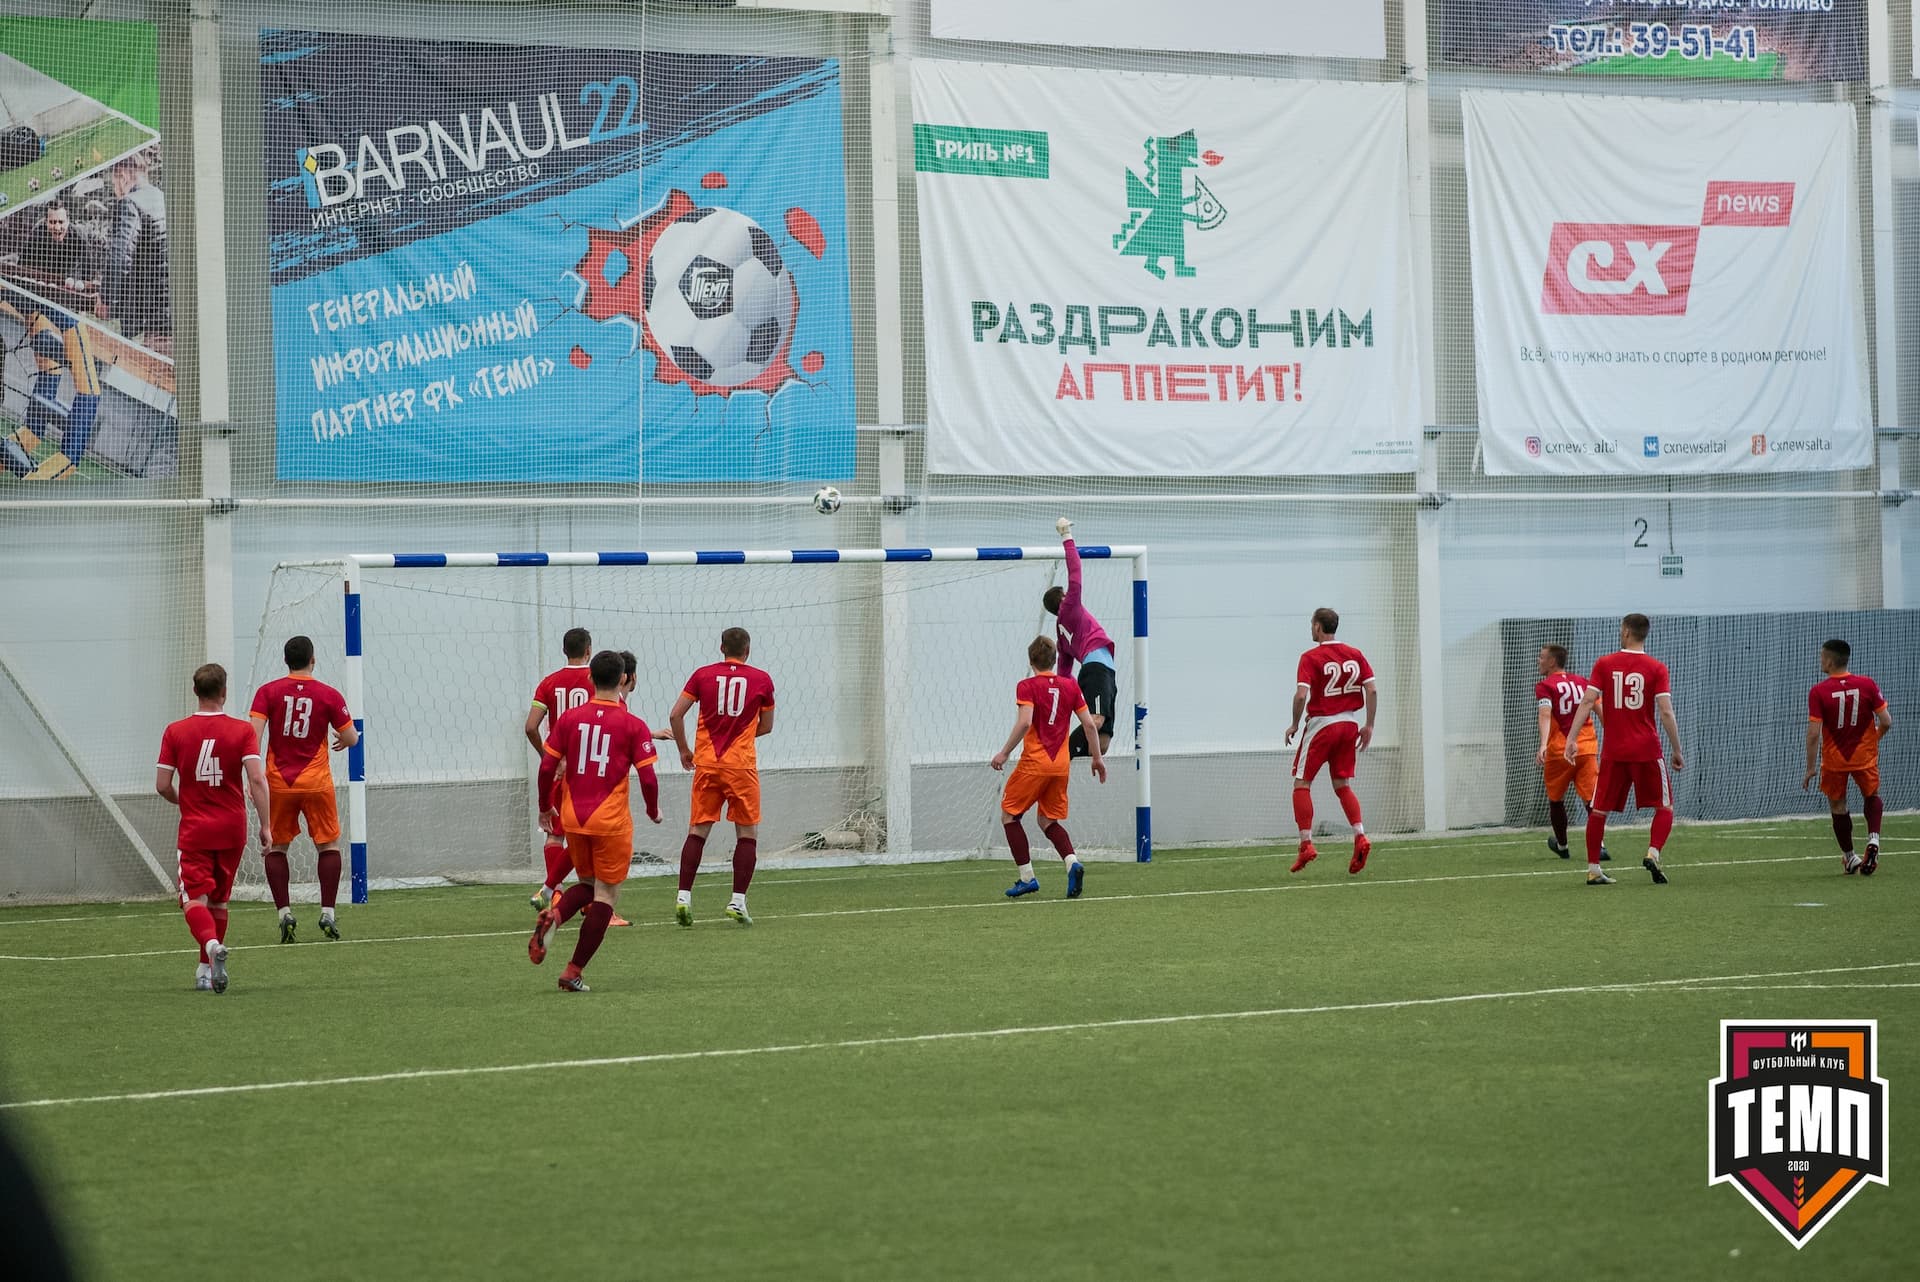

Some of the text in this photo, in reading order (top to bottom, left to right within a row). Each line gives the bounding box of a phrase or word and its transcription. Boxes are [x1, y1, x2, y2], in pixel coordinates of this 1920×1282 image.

[1550, 23, 1757, 60] тел.: 39-51-41
[935, 139, 1036, 164] ГРИЛЬ №1
[311, 194, 403, 229] ИНТЕРНЕТ
[419, 162, 541, 205] СООБЩЕСТВО
[1717, 192, 1780, 214] news
[307, 260, 477, 335] ГЕНЕРАЛЬНЫЙ
[310, 298, 539, 392] ИНФОРМАЦИОННЫЙ
[970, 300, 1374, 355] РАЗДРАКОНИМ
[1520, 346, 1827, 367] Всё, что нужно знать о спорте в родном регионе!
[311, 354, 556, 443] ПАРТНЕР ФК «ТЕМП»
[1055, 361, 1303, 402] АППЕТИТ!
[1663, 439, 1727, 455] cxnewsaltai
[1633, 517, 1648, 548] 2
[716, 675, 748, 717] 10
[1323, 659, 1361, 698] 22
[1556, 680, 1585, 715] 24
[1612, 671, 1645, 710] 13
[284, 695, 313, 739] 13
[1048, 688, 1060, 725] 7
[1832, 688, 1860, 729] 77
[195, 738, 224, 787] 4
[577, 723, 611, 778] 14
